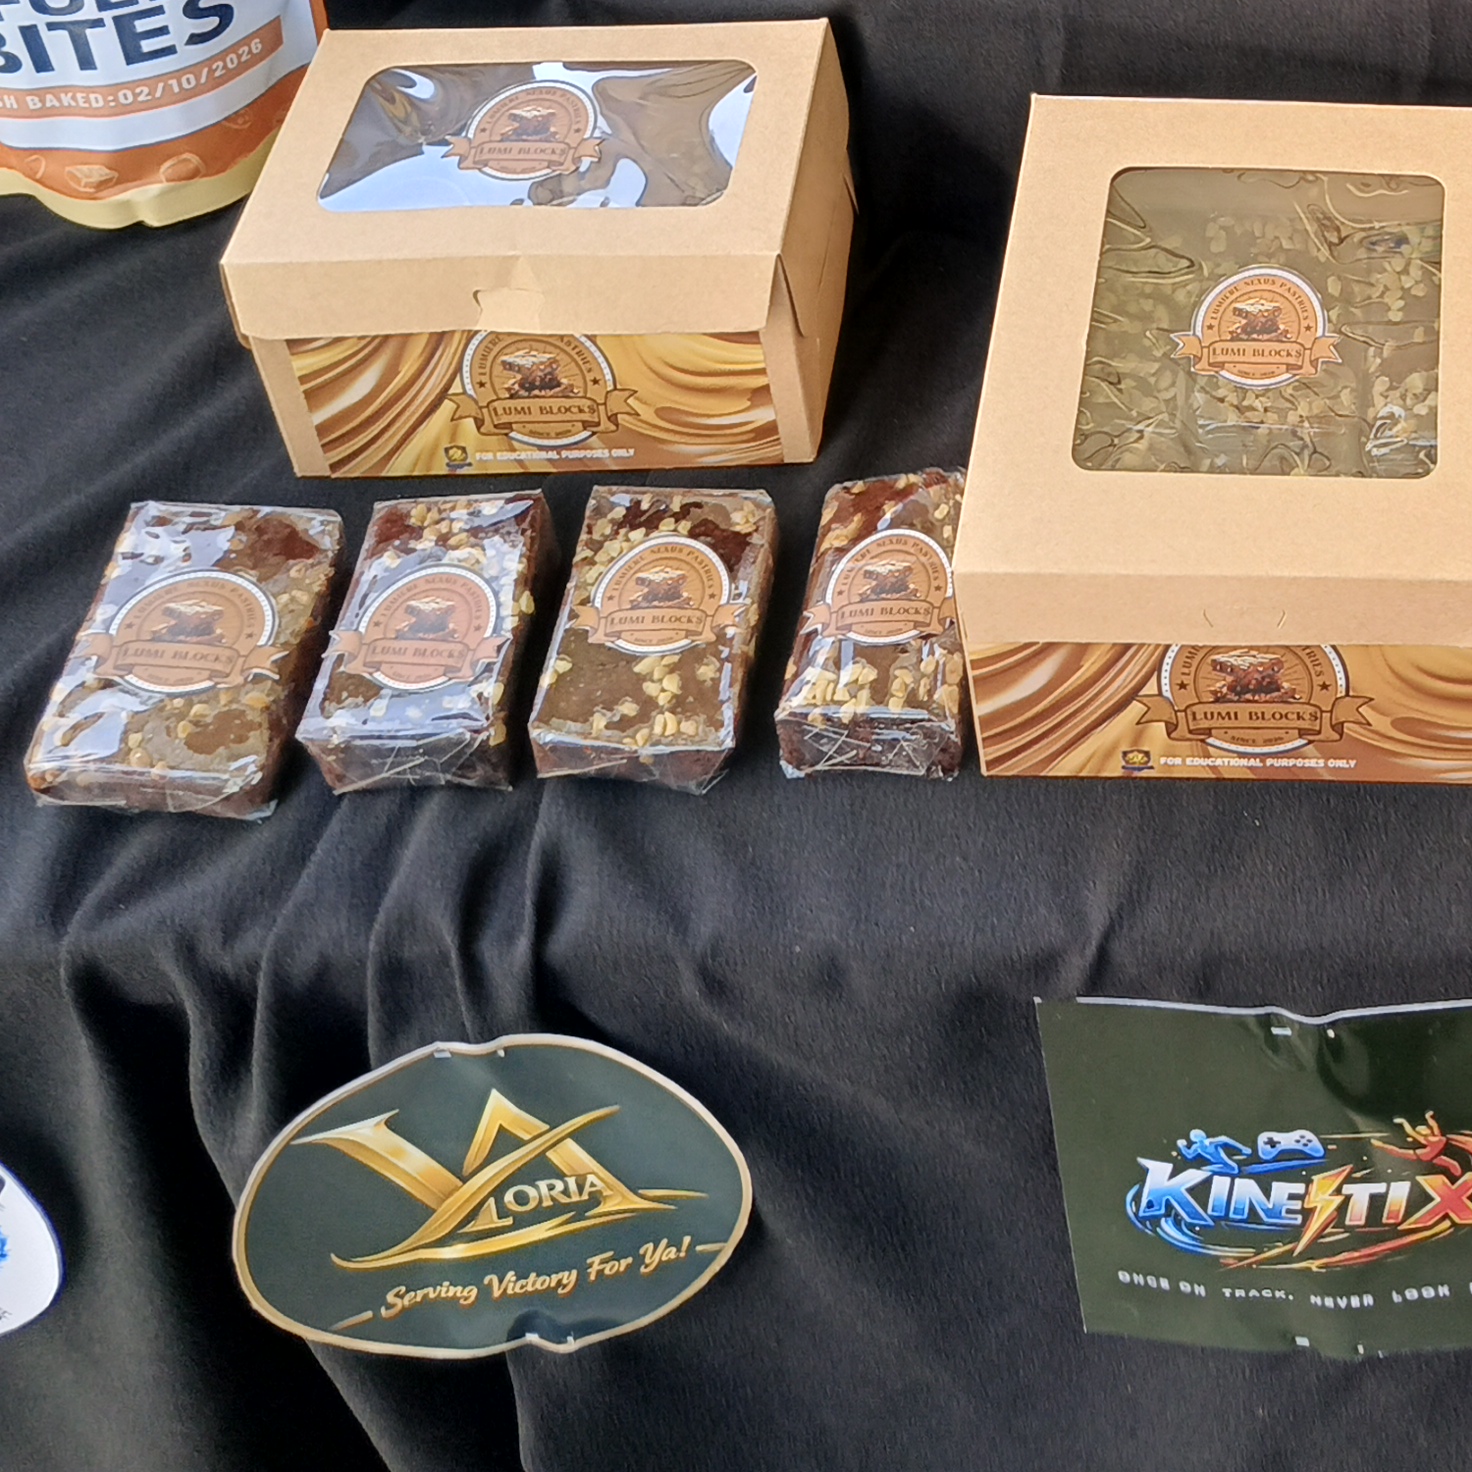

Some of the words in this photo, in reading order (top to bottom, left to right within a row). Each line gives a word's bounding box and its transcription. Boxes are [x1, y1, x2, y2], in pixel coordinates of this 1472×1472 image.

[1212, 347, 1247, 357] LUMI
[1252, 347, 1302, 358] BLOCKS
[492, 405, 533, 417] LUMI
[540, 403, 596, 415] BLOCKS
[476, 452, 494, 461] FOR
[497, 451, 560, 461] EDUCATIONAL
[562, 449, 609, 459] PURPOSES
[841, 607, 875, 619] LUMI
[880, 606, 931, 616] BLOCKS
[610, 615, 645, 625] LUMI
[651, 614, 703, 625] BLOCKS
[372, 645, 407, 655] LUMI
[413, 648, 465, 659] BLOCKS
[1191, 710, 1239, 722] LUMI
[1249, 710, 1319, 722] BLOCKS
[1159, 757, 1182, 766] FOR
[1186, 757, 1263, 767] EDUCATIONAL
[1266, 758, 1325, 768] PURPOSES
[1327, 758, 1357, 769] ONLY
[381, 1285, 478, 1319] Serving
[484, 1268, 578, 1300] Victory
[586, 1251, 633, 1281] For
[639, 1235, 692, 1274] Ya!
